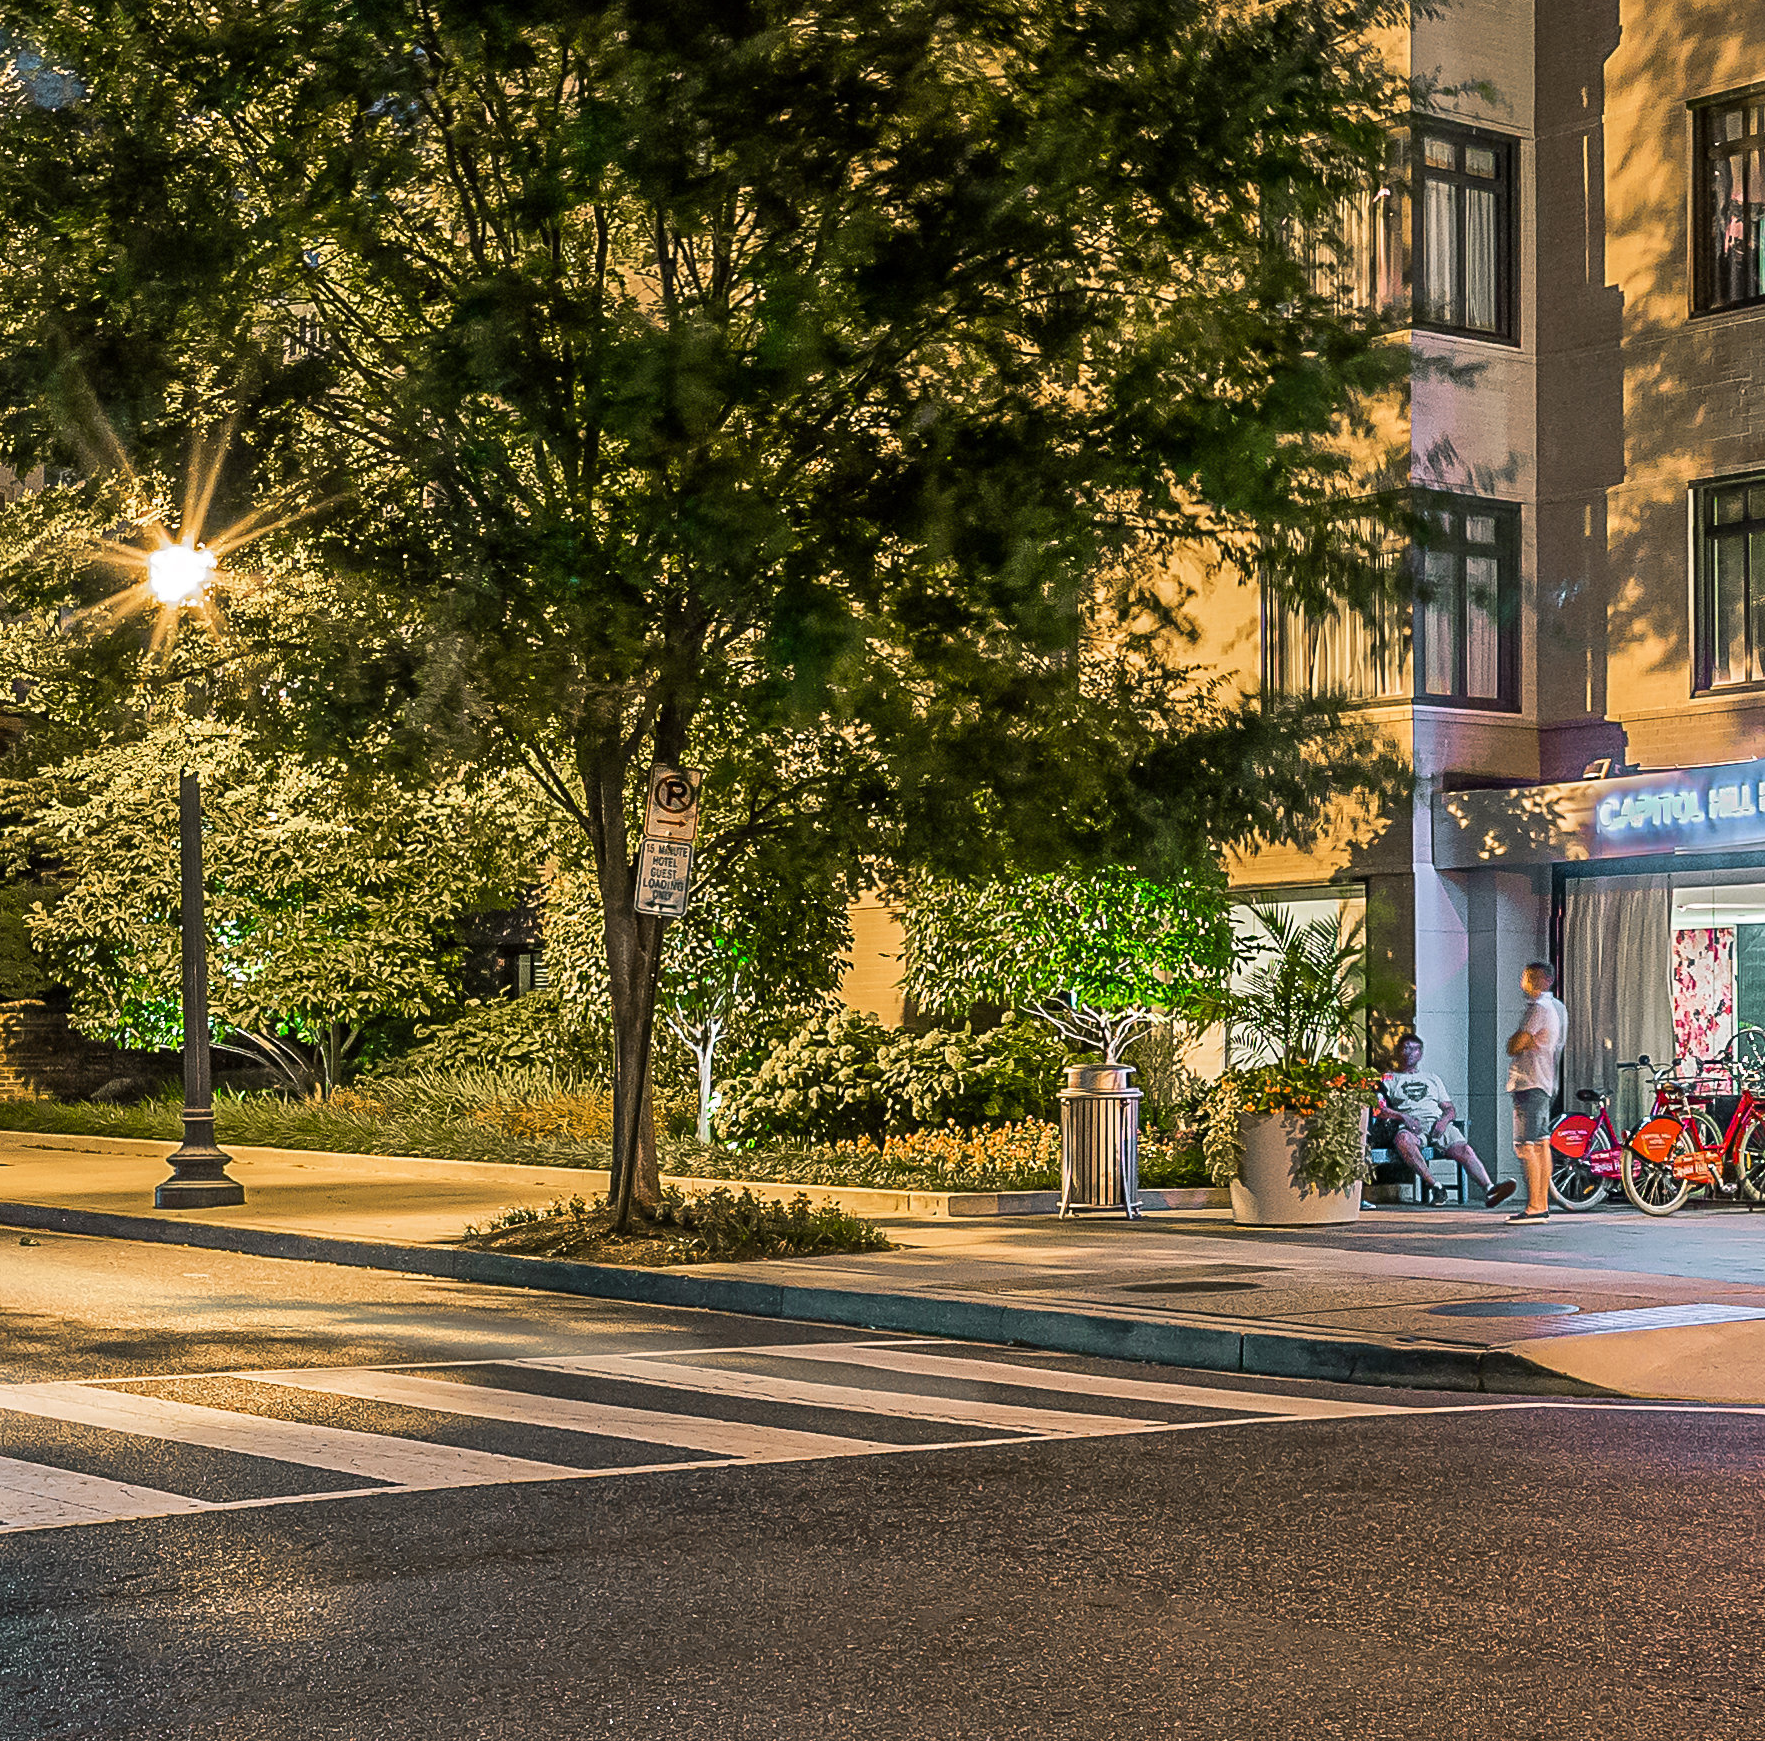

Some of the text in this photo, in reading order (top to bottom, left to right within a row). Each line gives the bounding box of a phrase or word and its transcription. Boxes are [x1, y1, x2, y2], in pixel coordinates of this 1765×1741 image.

[1599, 789, 1705, 831] CAPITOL
[658, 844, 688, 858] MINUTE
[652, 855, 678, 869] HOTEL
[650, 867, 677, 880] GUEST
[642, 877, 684, 892] LOADING
[652, 889, 673, 901] ONLY
